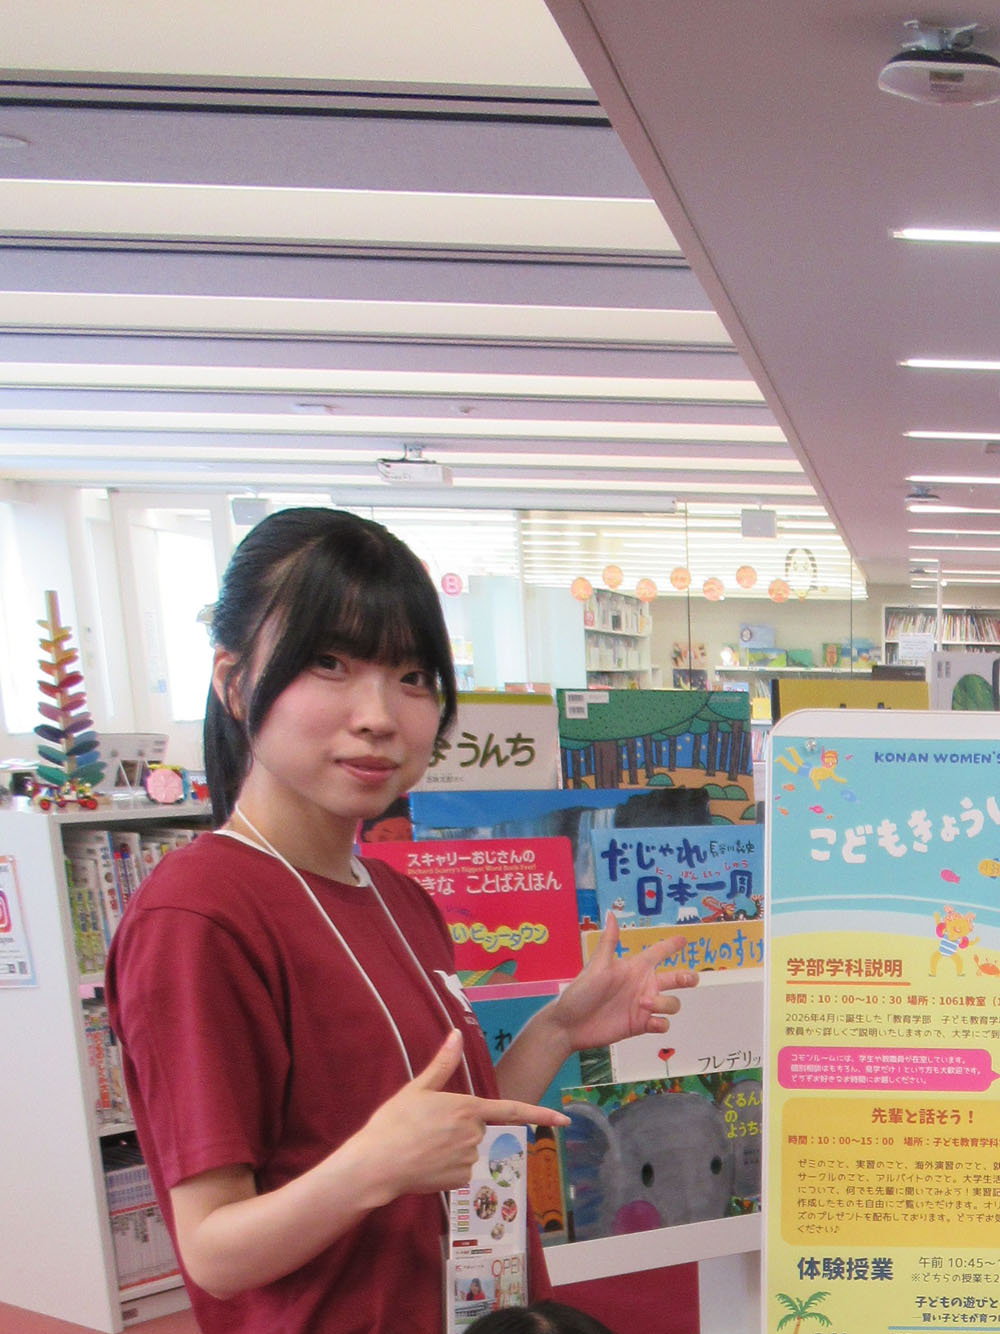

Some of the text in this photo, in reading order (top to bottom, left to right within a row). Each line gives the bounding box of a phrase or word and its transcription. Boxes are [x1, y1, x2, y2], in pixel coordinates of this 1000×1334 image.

[874, 751, 930, 765] KONAN
[408, 850, 536, 868] スキャリーおじさんの
[601, 838, 708, 882] だじゃれ
[466, 871, 562, 894] ことばえほん
[637, 869, 753, 917] 日本一周
[787, 958, 903, 978] 学部学科説明
[785, 1013, 932, 1026] 2026年4月に誕生した「教育学部
[724, 1090, 763, 1109] ぐるん
[725, 1110, 738, 1123] の
[871, 1108, 975, 1125] 先輩と話そう！
[727, 1121, 763, 1138] ようち
[797, 1256, 895, 1281] 体験授業
[918, 1257, 944, 1269] 午前
